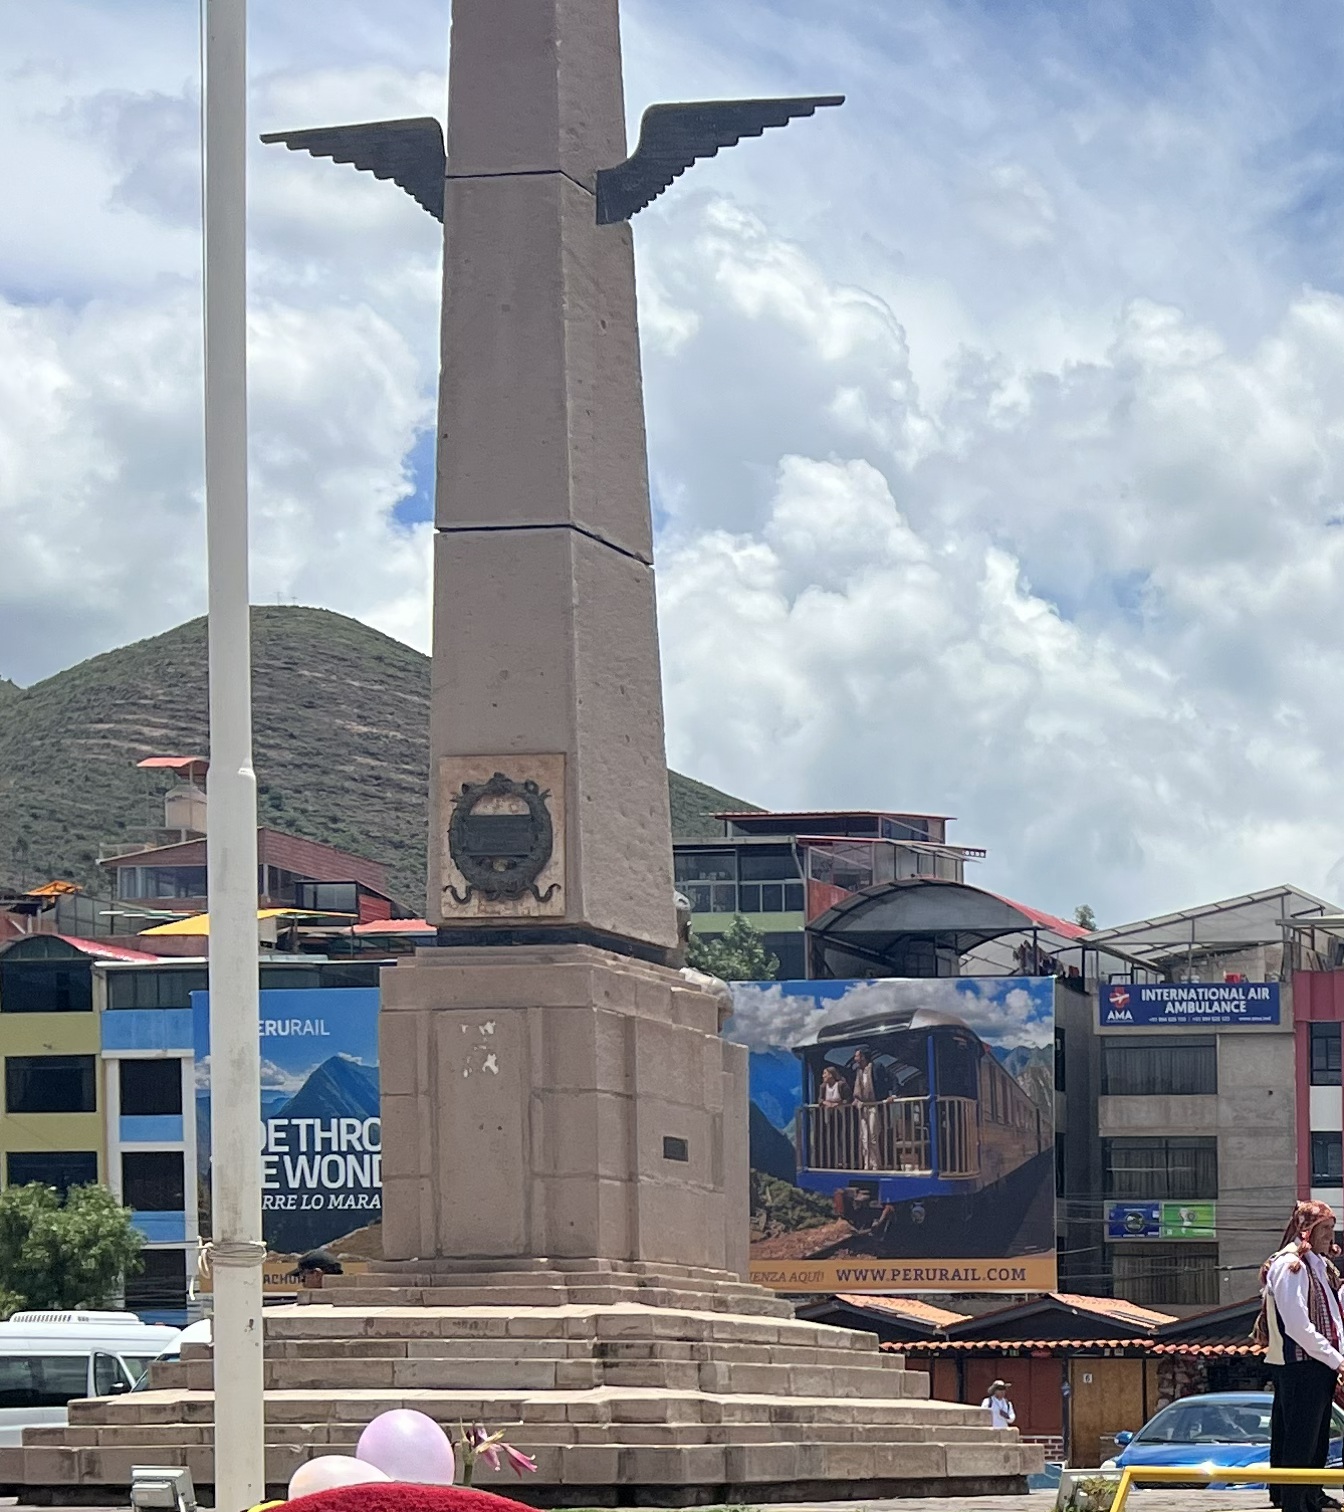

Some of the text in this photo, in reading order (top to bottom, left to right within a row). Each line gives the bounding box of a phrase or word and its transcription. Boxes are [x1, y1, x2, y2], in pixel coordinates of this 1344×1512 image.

[1141, 987, 1270, 1002] INTERNATIONAL AIR
[1164, 1001, 1247, 1014] AMBULANCE
[1107, 1010, 1133, 1021] AMA
[291, 1117, 382, 1152] THRO
[300, 1194, 324, 1210] LO
[327, 1194, 382, 1209] MARA
[836, 1267, 1027, 1282] WWW.PERURAIL.COM
